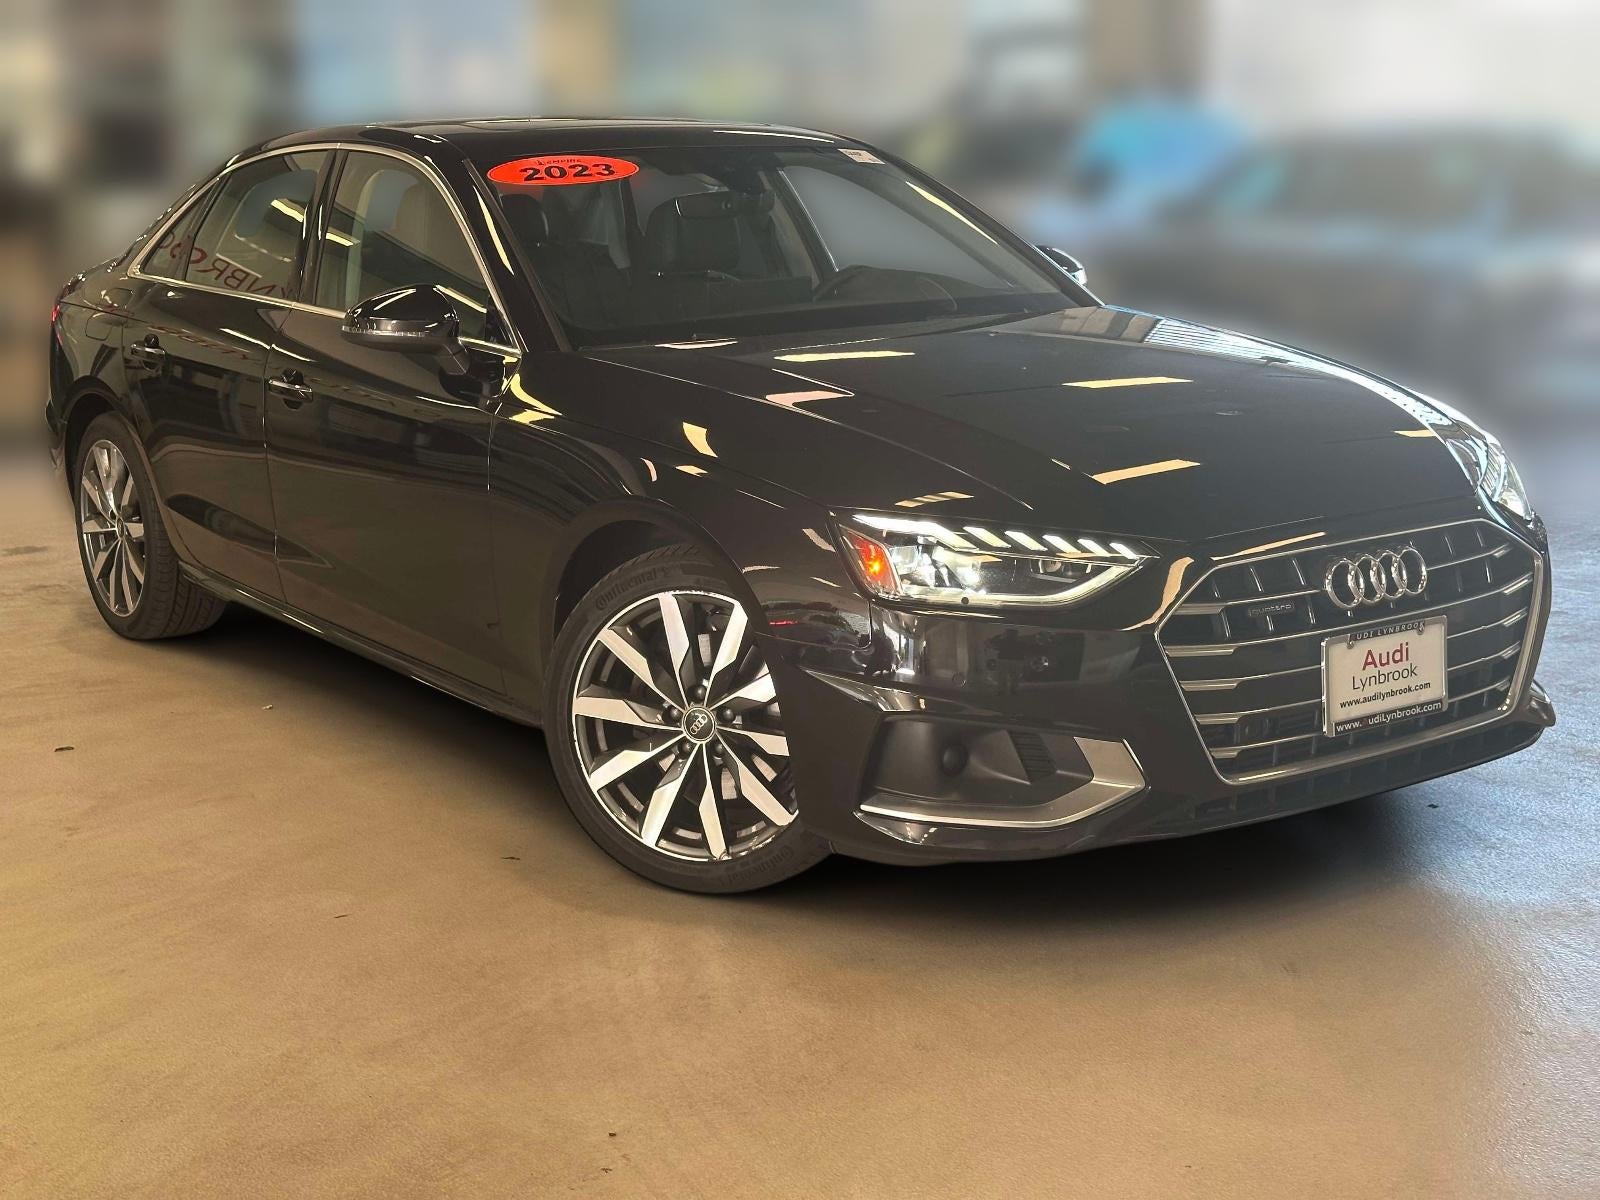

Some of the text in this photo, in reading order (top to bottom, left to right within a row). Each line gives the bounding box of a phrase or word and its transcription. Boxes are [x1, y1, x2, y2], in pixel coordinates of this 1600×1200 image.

[519, 163, 616, 182] 2023
[1377, 622, 1425, 636] LYNBROOK
[1362, 642, 1409, 671] Audi
[1352, 662, 1418, 692] Lynbrook
[1340, 681, 1431, 709] www.audilynbrook.com
